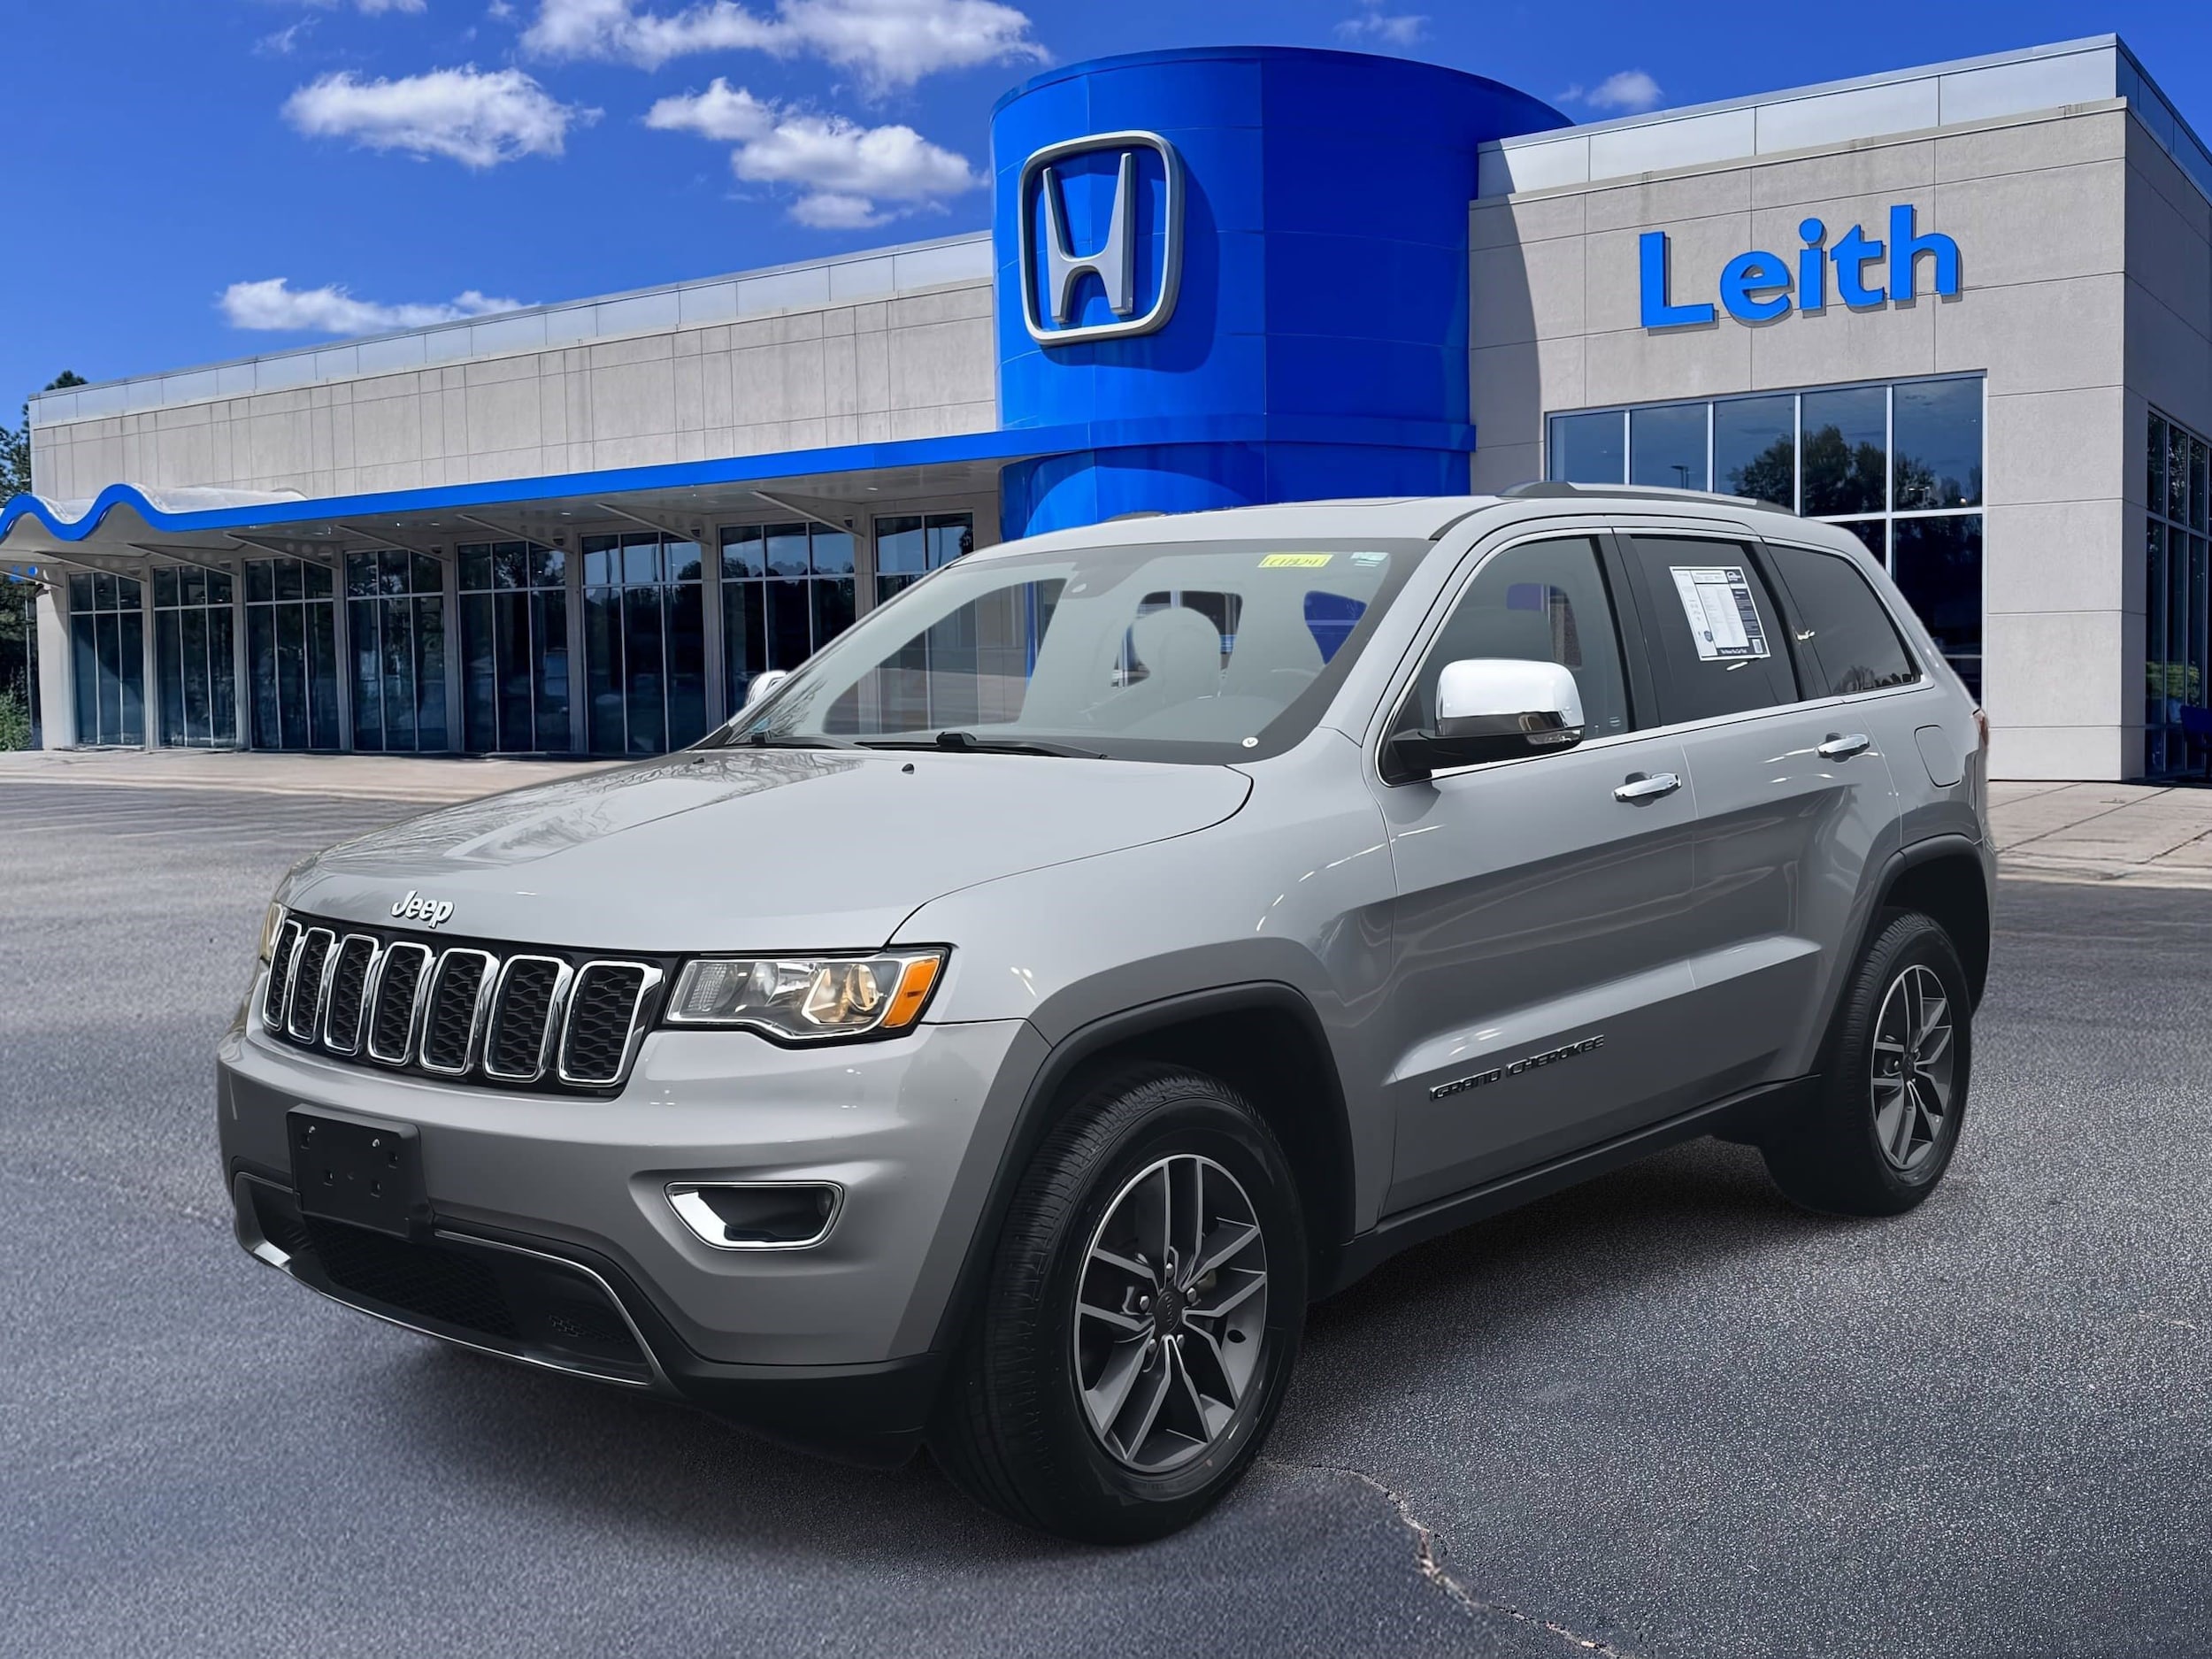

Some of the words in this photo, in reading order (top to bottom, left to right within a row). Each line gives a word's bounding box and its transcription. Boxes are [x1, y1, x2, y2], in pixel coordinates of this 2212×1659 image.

[1640, 204, 1959, 328] Leith
[391, 890, 455, 929] Jeep
[1429, 1067, 1502, 1102] GRAND
[1505, 1033, 1605, 1078] CHEROKEE
